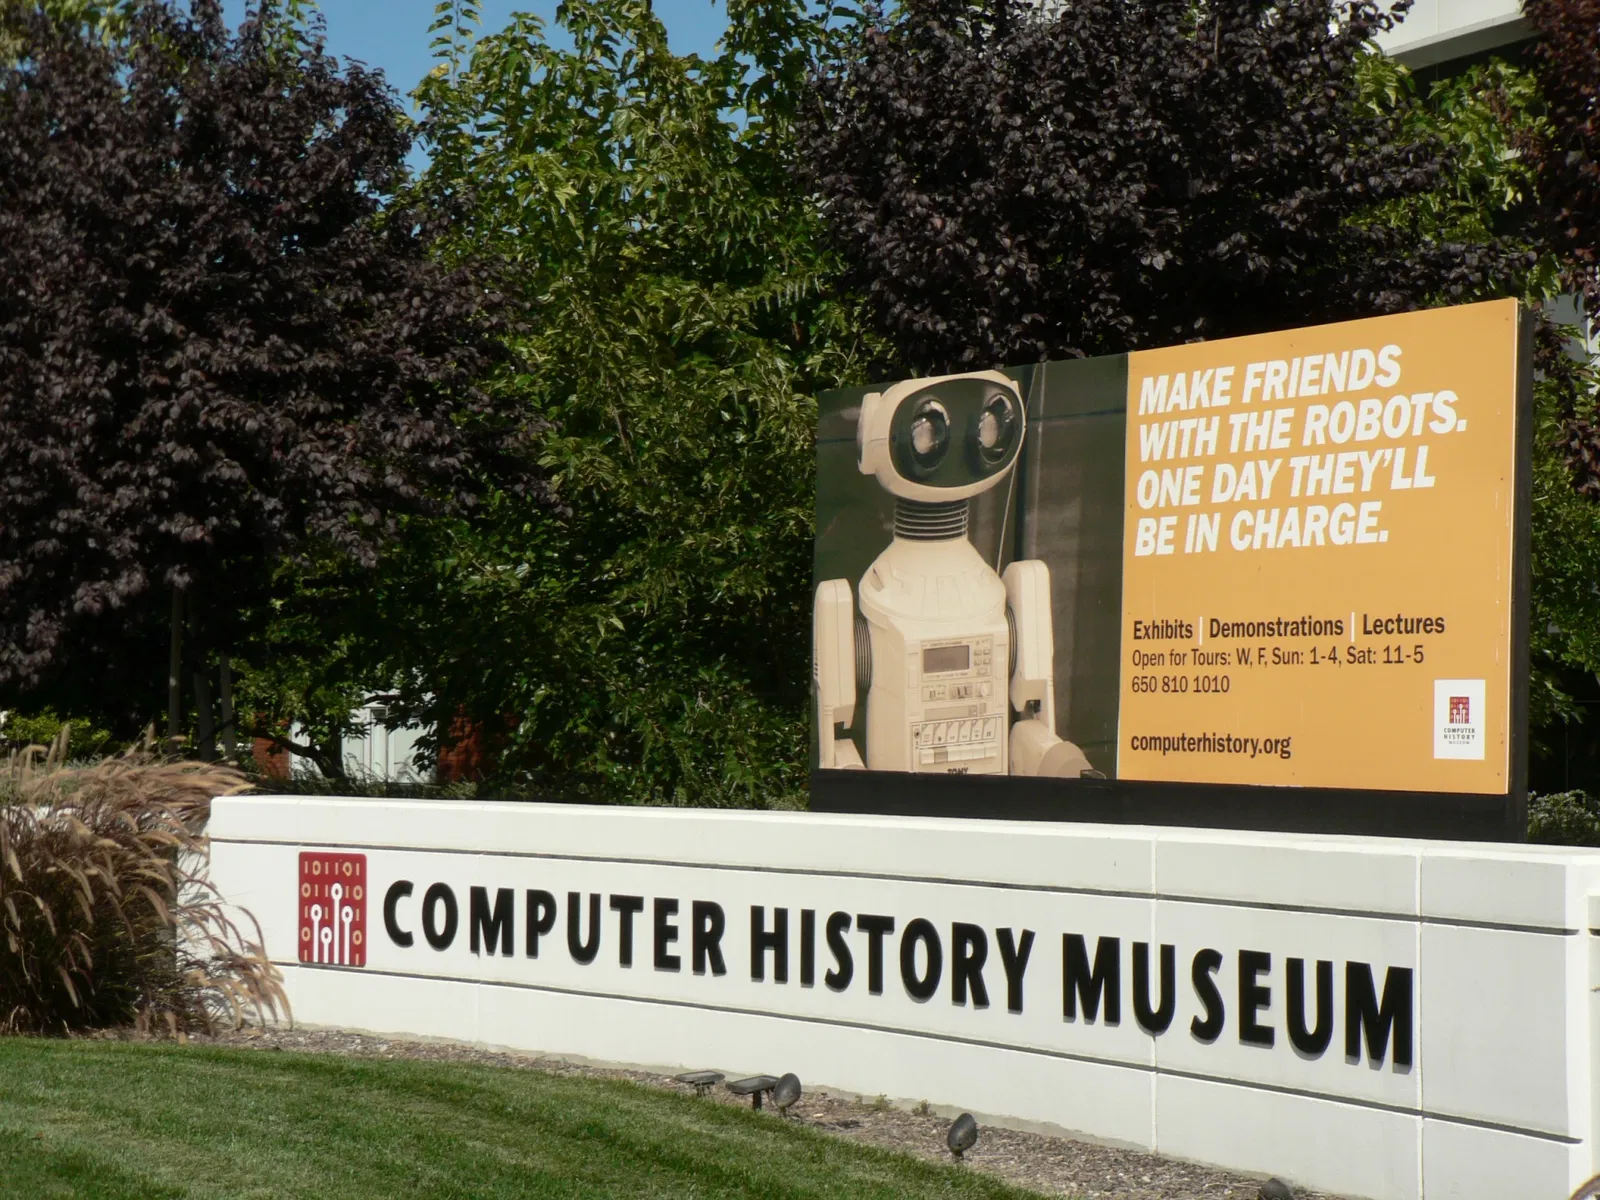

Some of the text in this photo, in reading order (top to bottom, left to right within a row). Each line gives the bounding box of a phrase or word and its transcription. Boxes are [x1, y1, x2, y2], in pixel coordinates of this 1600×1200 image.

[1138, 344, 1402, 415] MAKE FRIENDS
[1139, 390, 1468, 462] WITH THE ROBOTS.
[1137, 445, 1436, 509] ONE DAY THEY'LL
[1135, 501, 1389, 557] BE IN CHARGE.
[1133, 613, 1446, 640] Exhibits Demonstrations Lectures
[1132, 644, 1424, 670] Open for Tours: W, F, Sun: 1-4, Sat: 11-5
[1132, 675, 1230, 693] 650 810 1010
[1130, 732, 1292, 760] computerhistory.org
[382, 879, 1414, 1075] COMPUTER HISTORY MUSEUM
